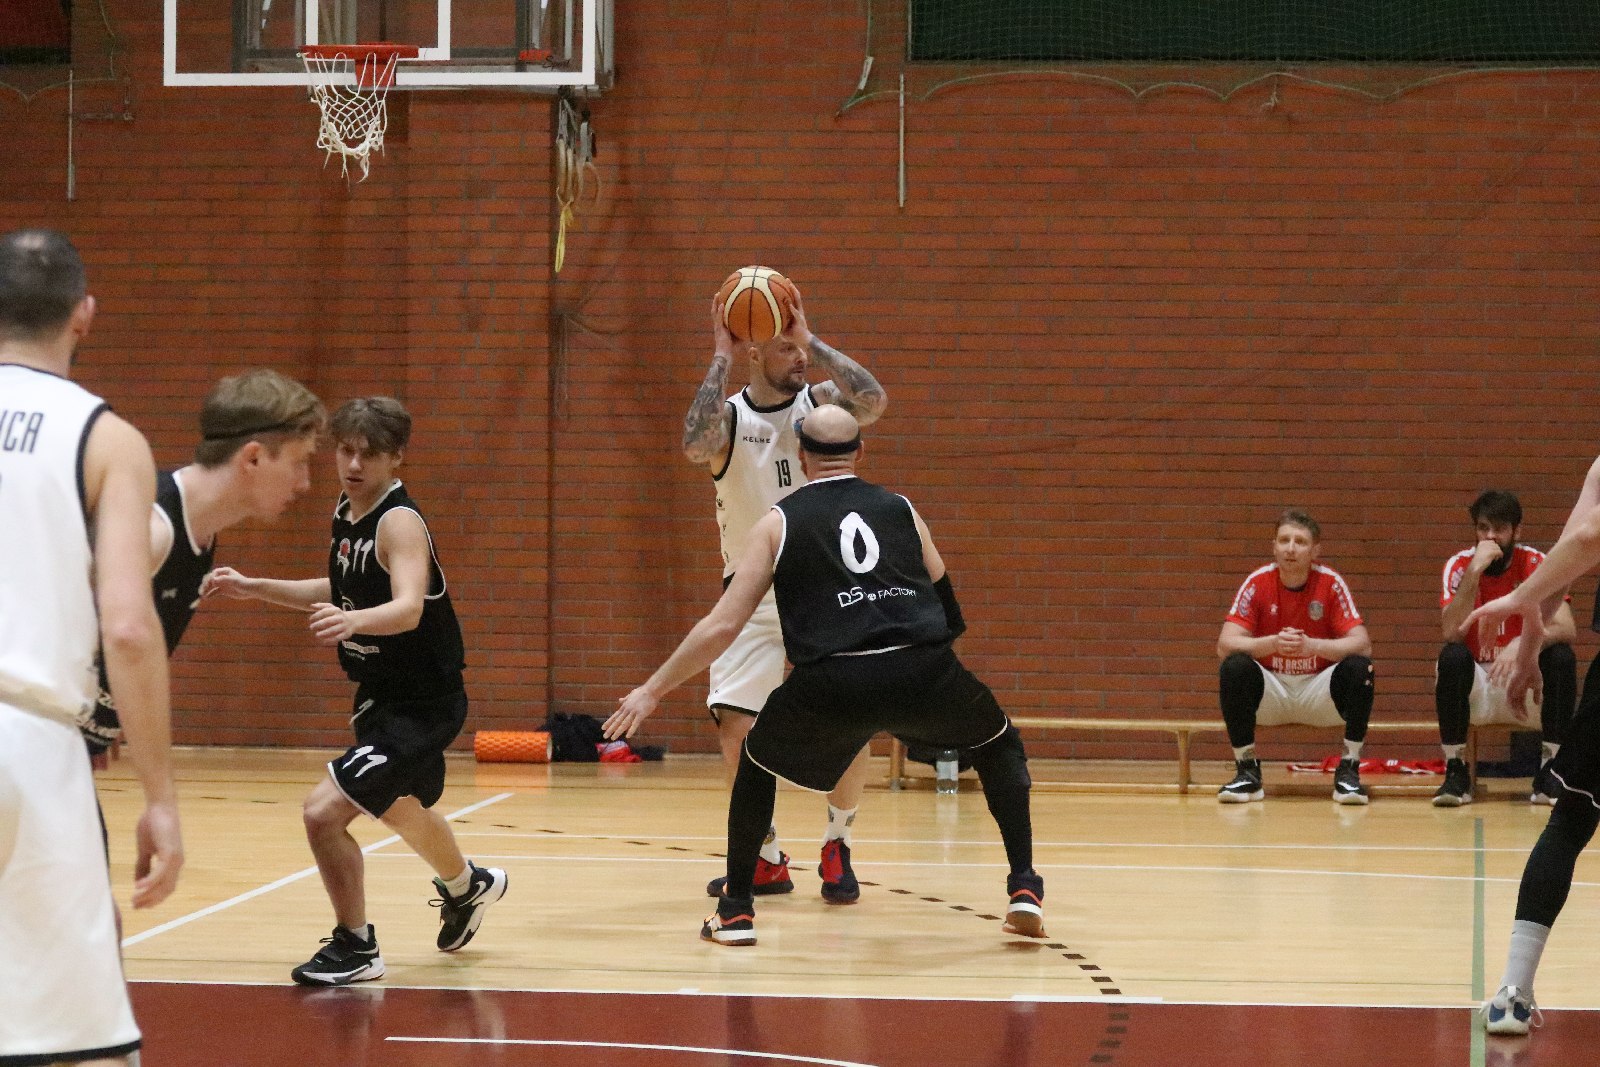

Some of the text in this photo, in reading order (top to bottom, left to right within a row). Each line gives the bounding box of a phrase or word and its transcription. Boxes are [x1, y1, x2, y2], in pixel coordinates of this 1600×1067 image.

[775, 459, 792, 488] 19
[839, 511, 880, 574] 0
[837, 586, 917, 608] DS FACTORY
